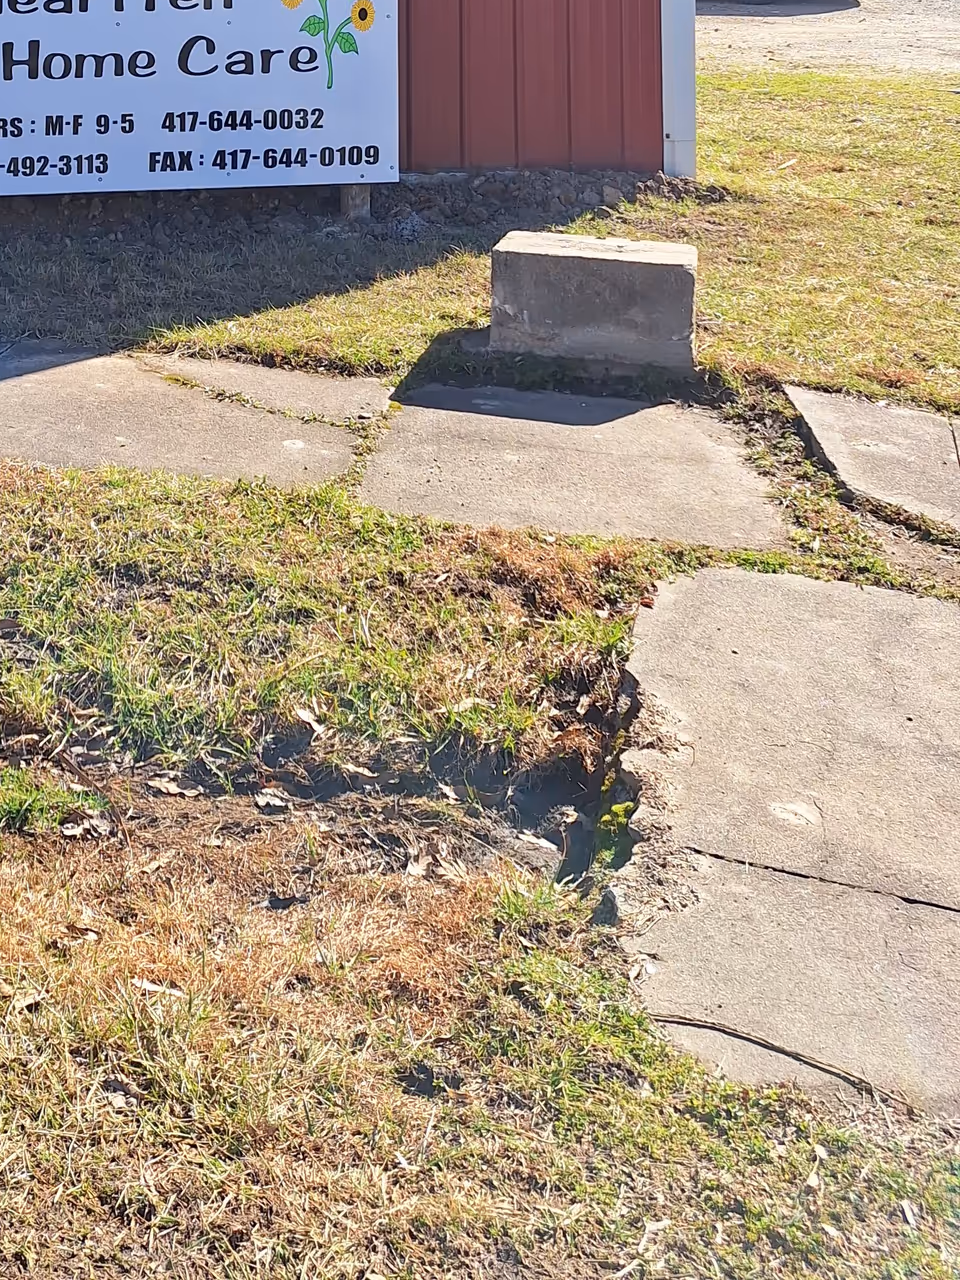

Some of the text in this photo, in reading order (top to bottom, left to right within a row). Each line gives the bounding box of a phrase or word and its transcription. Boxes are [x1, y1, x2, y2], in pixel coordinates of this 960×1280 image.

[2, 39, 157, 82] Home
[177, 35, 320, 76] Care
[45, 115, 84, 135] M-F
[96, 113, 135, 134] 9-5
[161, 108, 324, 132] 417-644-0032
[212, 145, 380, 170] 417-644-0109
